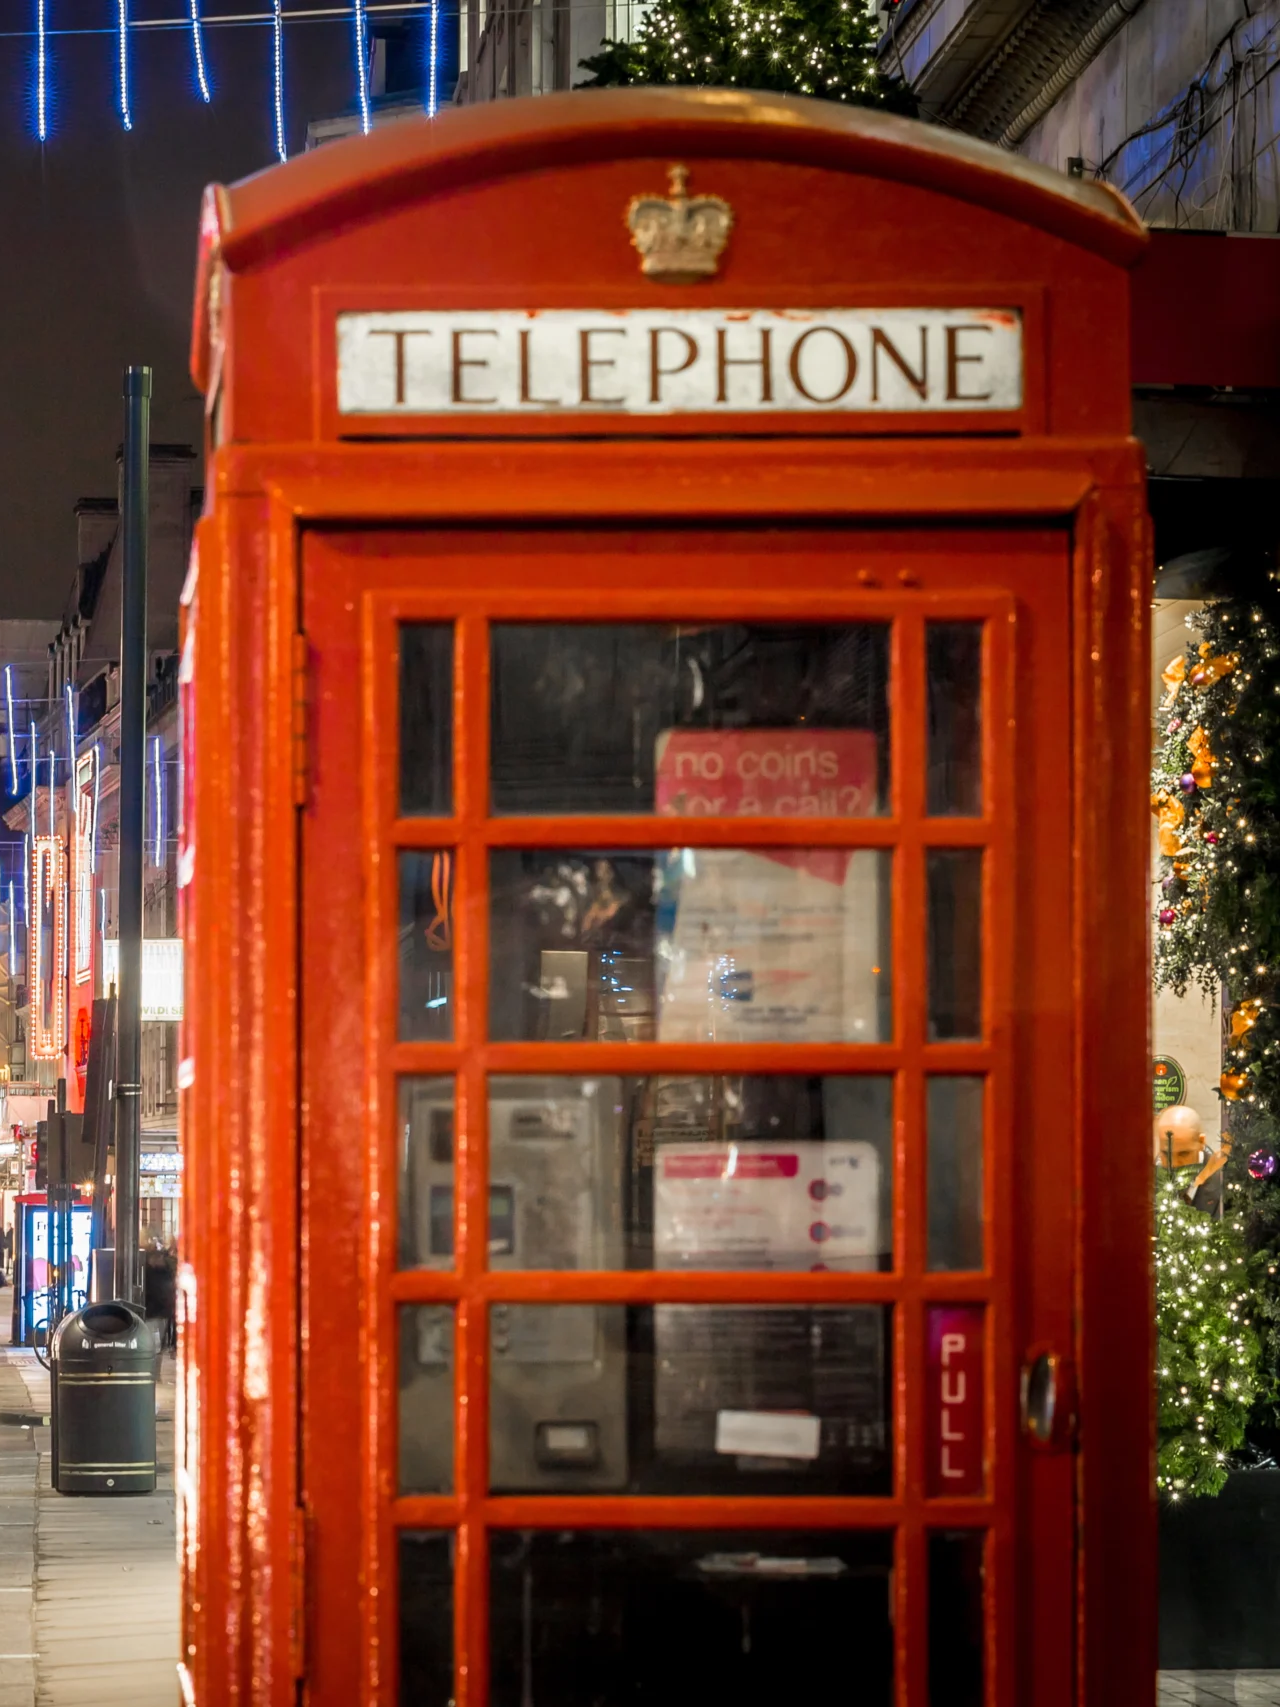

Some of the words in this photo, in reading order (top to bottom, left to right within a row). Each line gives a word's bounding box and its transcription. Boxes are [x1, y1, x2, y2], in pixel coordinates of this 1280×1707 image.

[367, 323, 995, 405] TELEPHONE
[674, 750, 724, 781] no
[736, 744, 839, 780] coins
[93, 1341, 114, 1349] general
[940, 1332, 967, 1479] PULL
